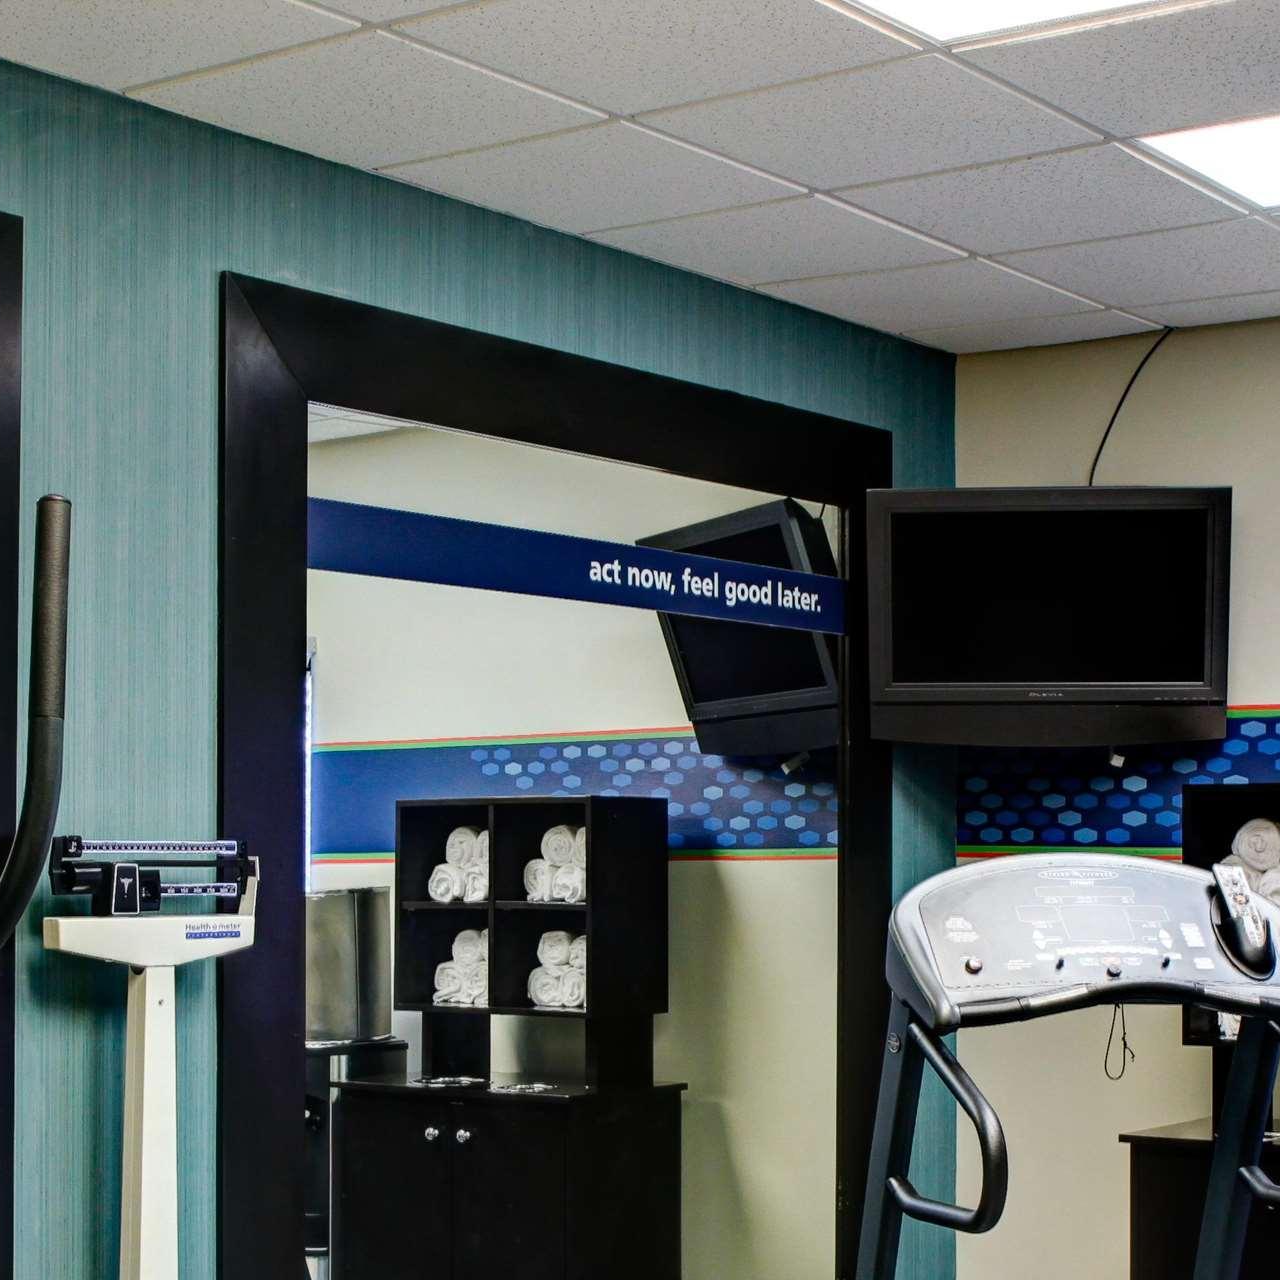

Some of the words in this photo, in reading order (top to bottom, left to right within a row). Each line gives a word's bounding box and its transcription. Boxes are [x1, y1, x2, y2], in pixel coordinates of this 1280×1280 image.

[589, 558, 622, 584] act
[627, 565, 677, 596] now,
[681, 567, 720, 598] feel
[724, 579, 772, 608] good
[777, 581, 822, 613] later.
